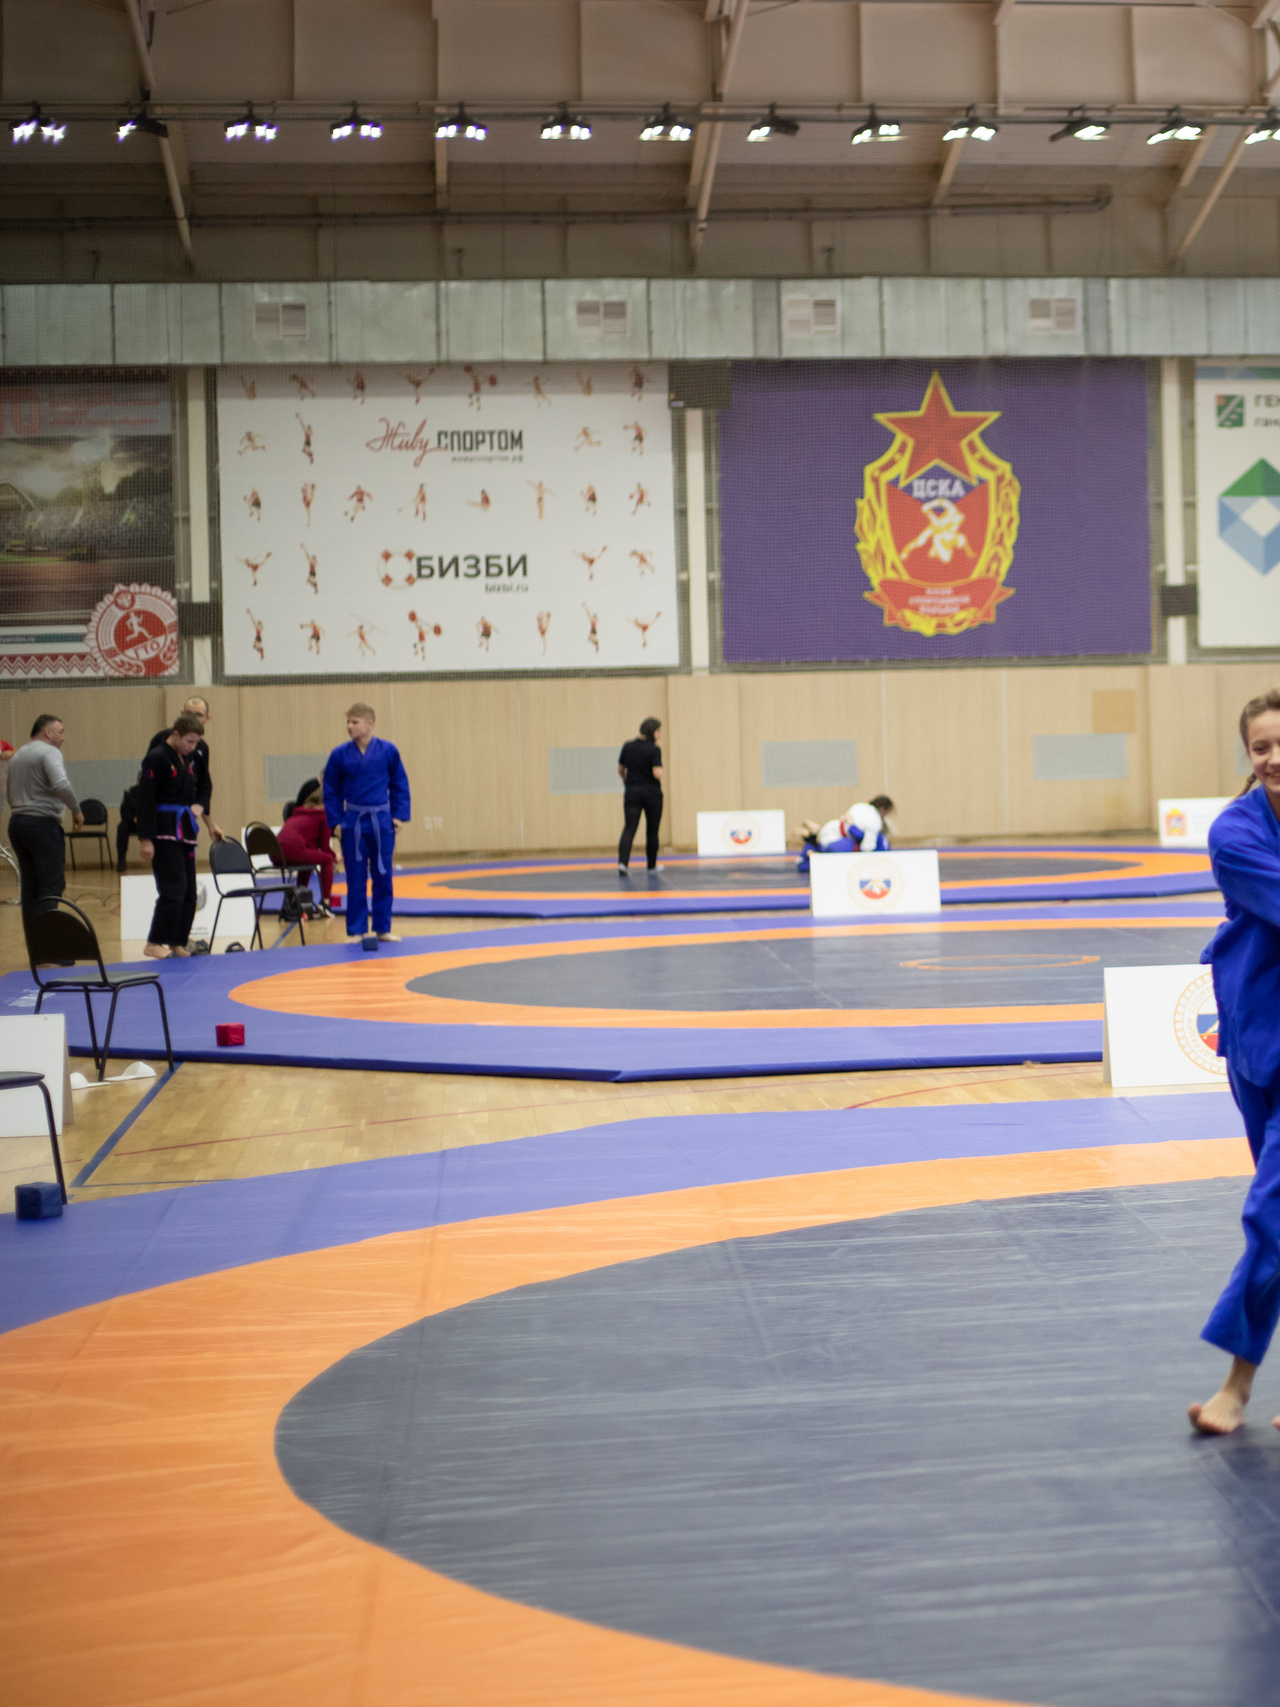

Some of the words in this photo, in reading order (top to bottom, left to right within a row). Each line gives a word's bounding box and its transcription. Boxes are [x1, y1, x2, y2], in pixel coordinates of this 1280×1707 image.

[437, 430, 523, 452] СПОРТОМ
[912, 478, 966, 499] ЦСКА
[416, 553, 528, 580] БИЗБИ
[133, 640, 160, 660] ГТО
